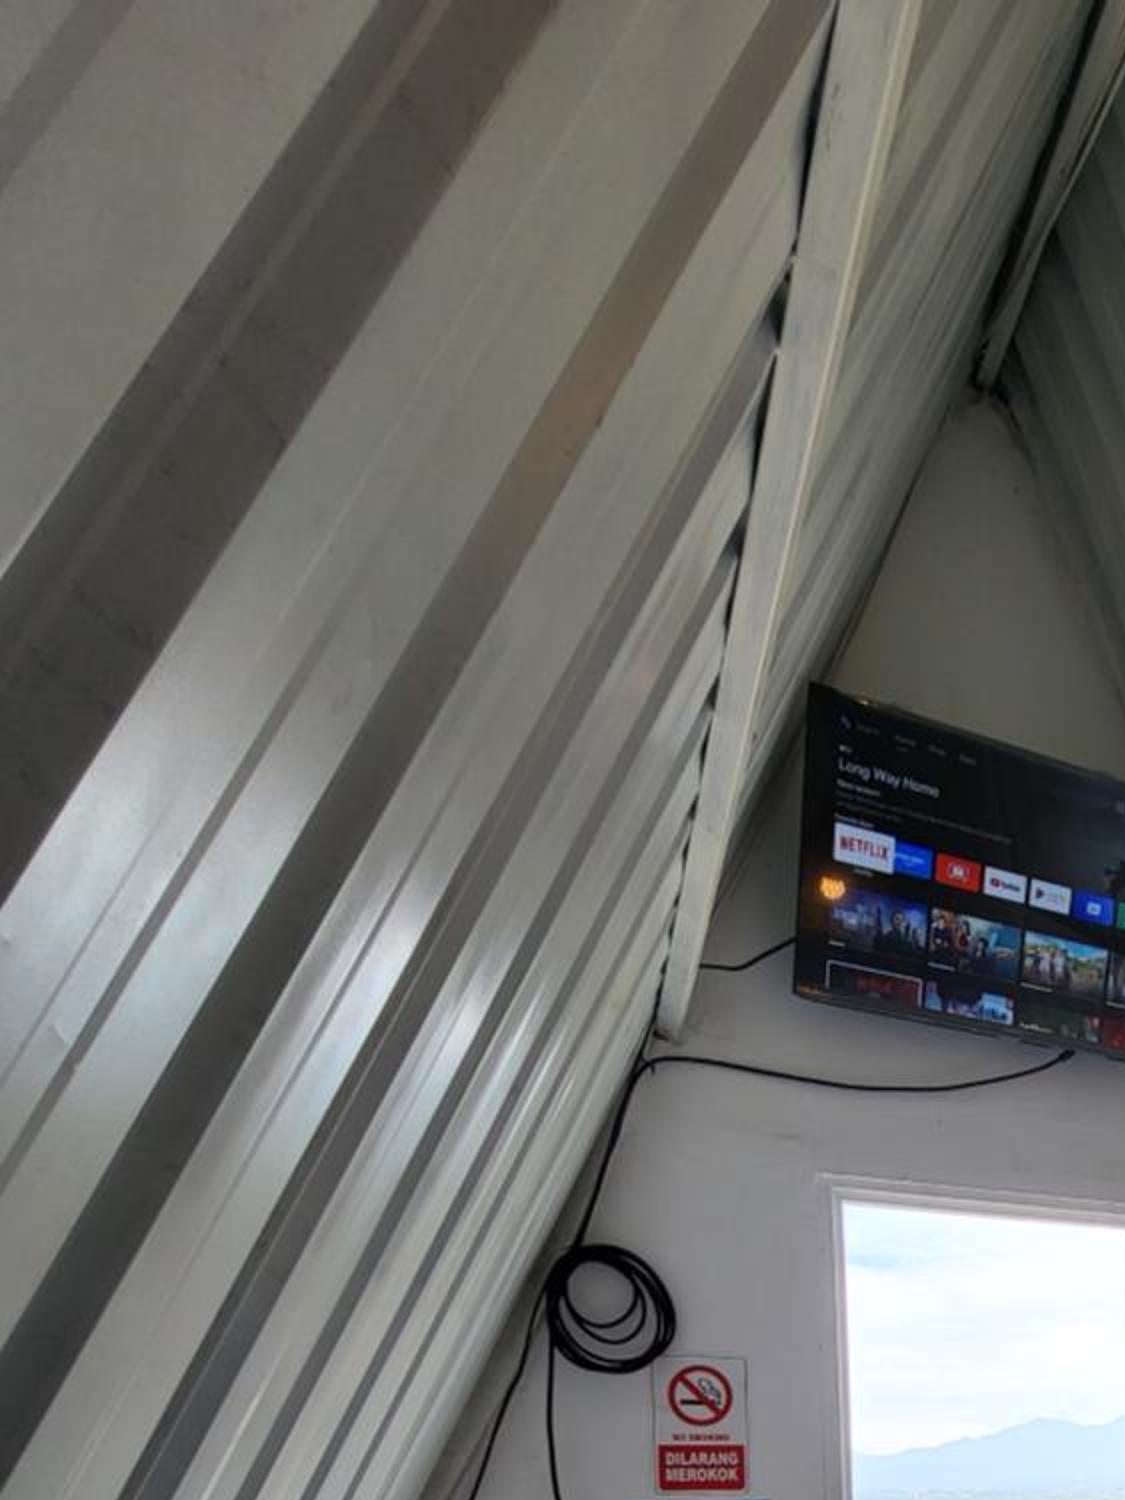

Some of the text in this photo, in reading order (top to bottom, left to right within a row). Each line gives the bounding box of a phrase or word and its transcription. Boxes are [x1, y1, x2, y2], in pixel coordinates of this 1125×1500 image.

[838, 757, 872, 781] Long
[873, 767, 900, 789] Way
[902, 776, 940, 799] Home
[839, 834, 889, 861] NETFLIX
[665, 1451, 738, 1466] DILARANG
[665, 1468, 738, 1482] MEROKOK
